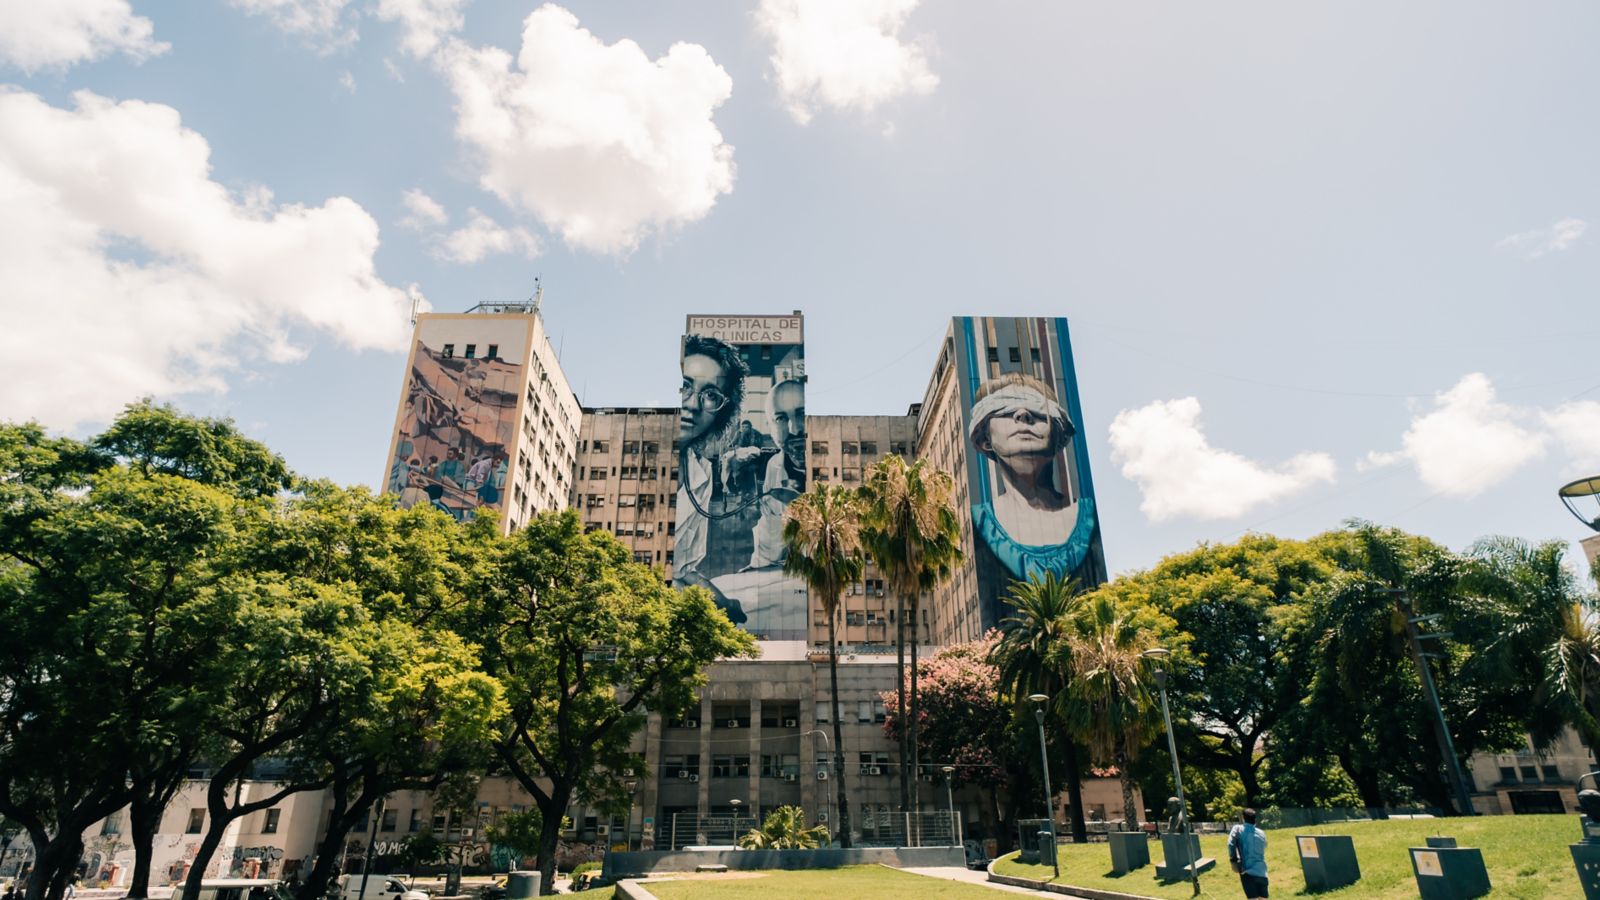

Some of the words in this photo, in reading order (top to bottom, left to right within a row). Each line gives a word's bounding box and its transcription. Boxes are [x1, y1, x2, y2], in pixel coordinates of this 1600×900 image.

[693, 318, 771, 329] HOSPITAL
[779, 318, 799, 329] DE
[712, 331, 782, 342] CLINICAS
